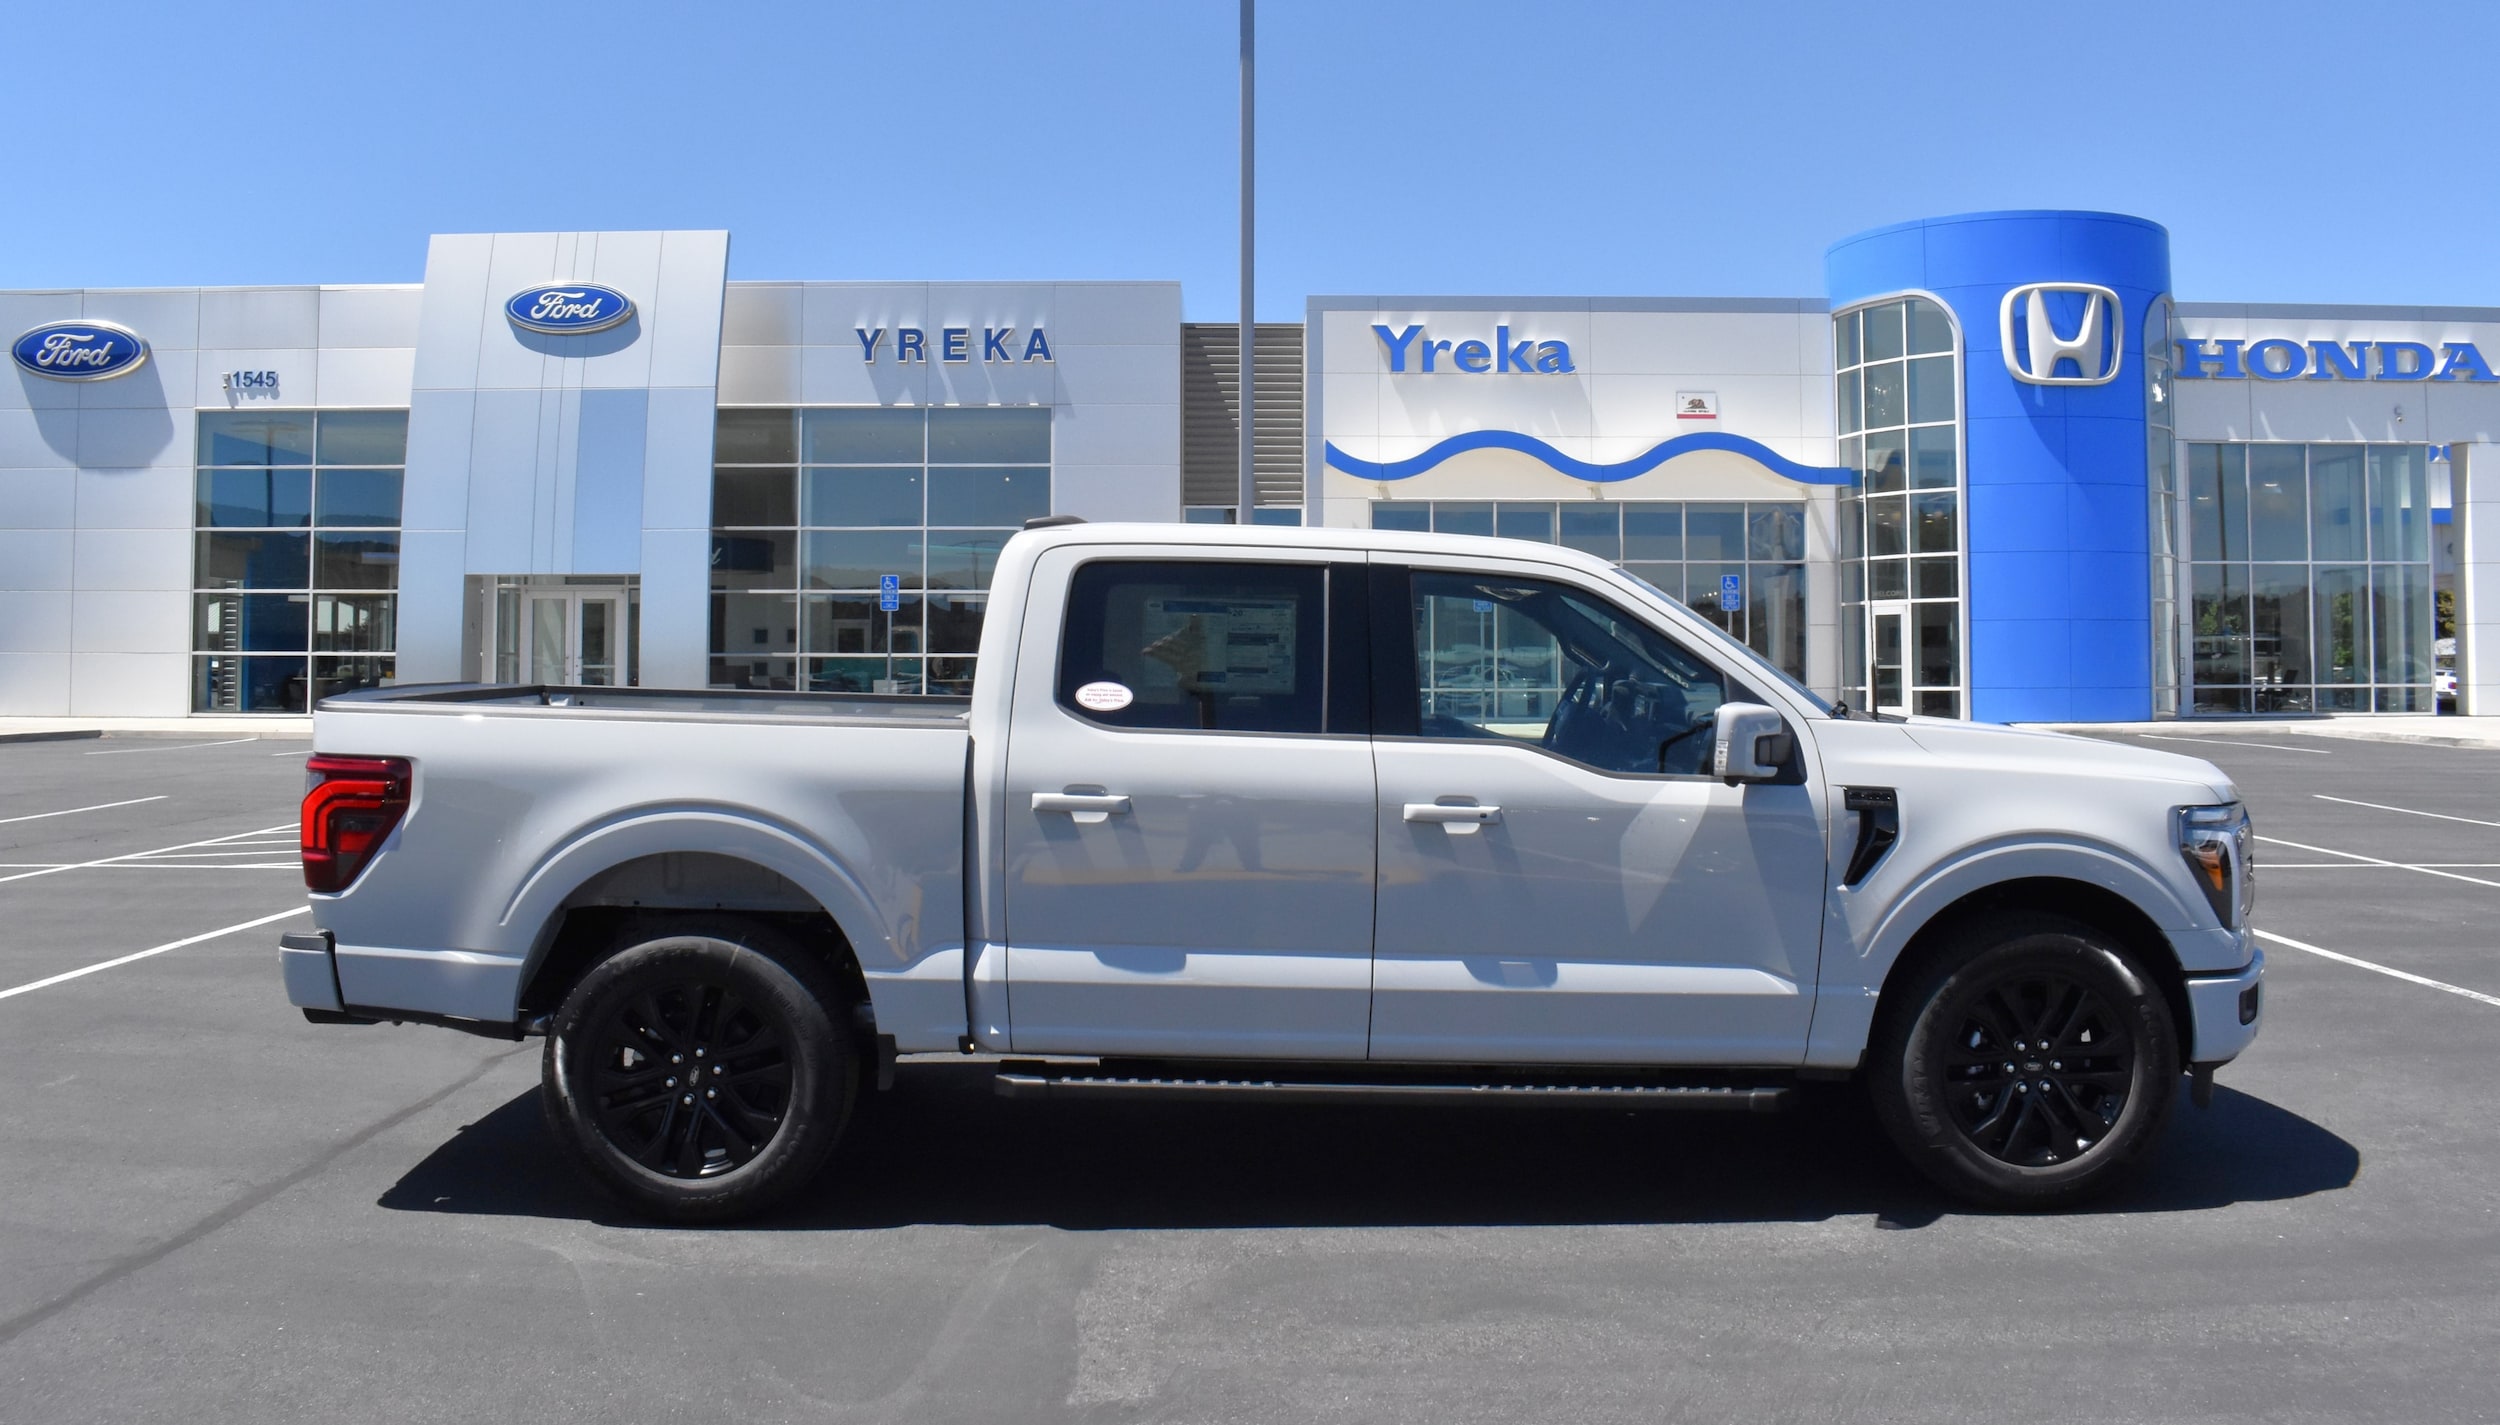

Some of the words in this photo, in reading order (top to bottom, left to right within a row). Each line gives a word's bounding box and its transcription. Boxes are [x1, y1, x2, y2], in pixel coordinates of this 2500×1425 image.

[530, 291, 603, 319] Ford
[36, 333, 114, 366] Ford
[854, 327, 1055, 363] YREKA
[1371, 324, 1576, 374] Yreka
[2174, 338, 2500, 382] HONDA
[232, 370, 277, 388] 1545
